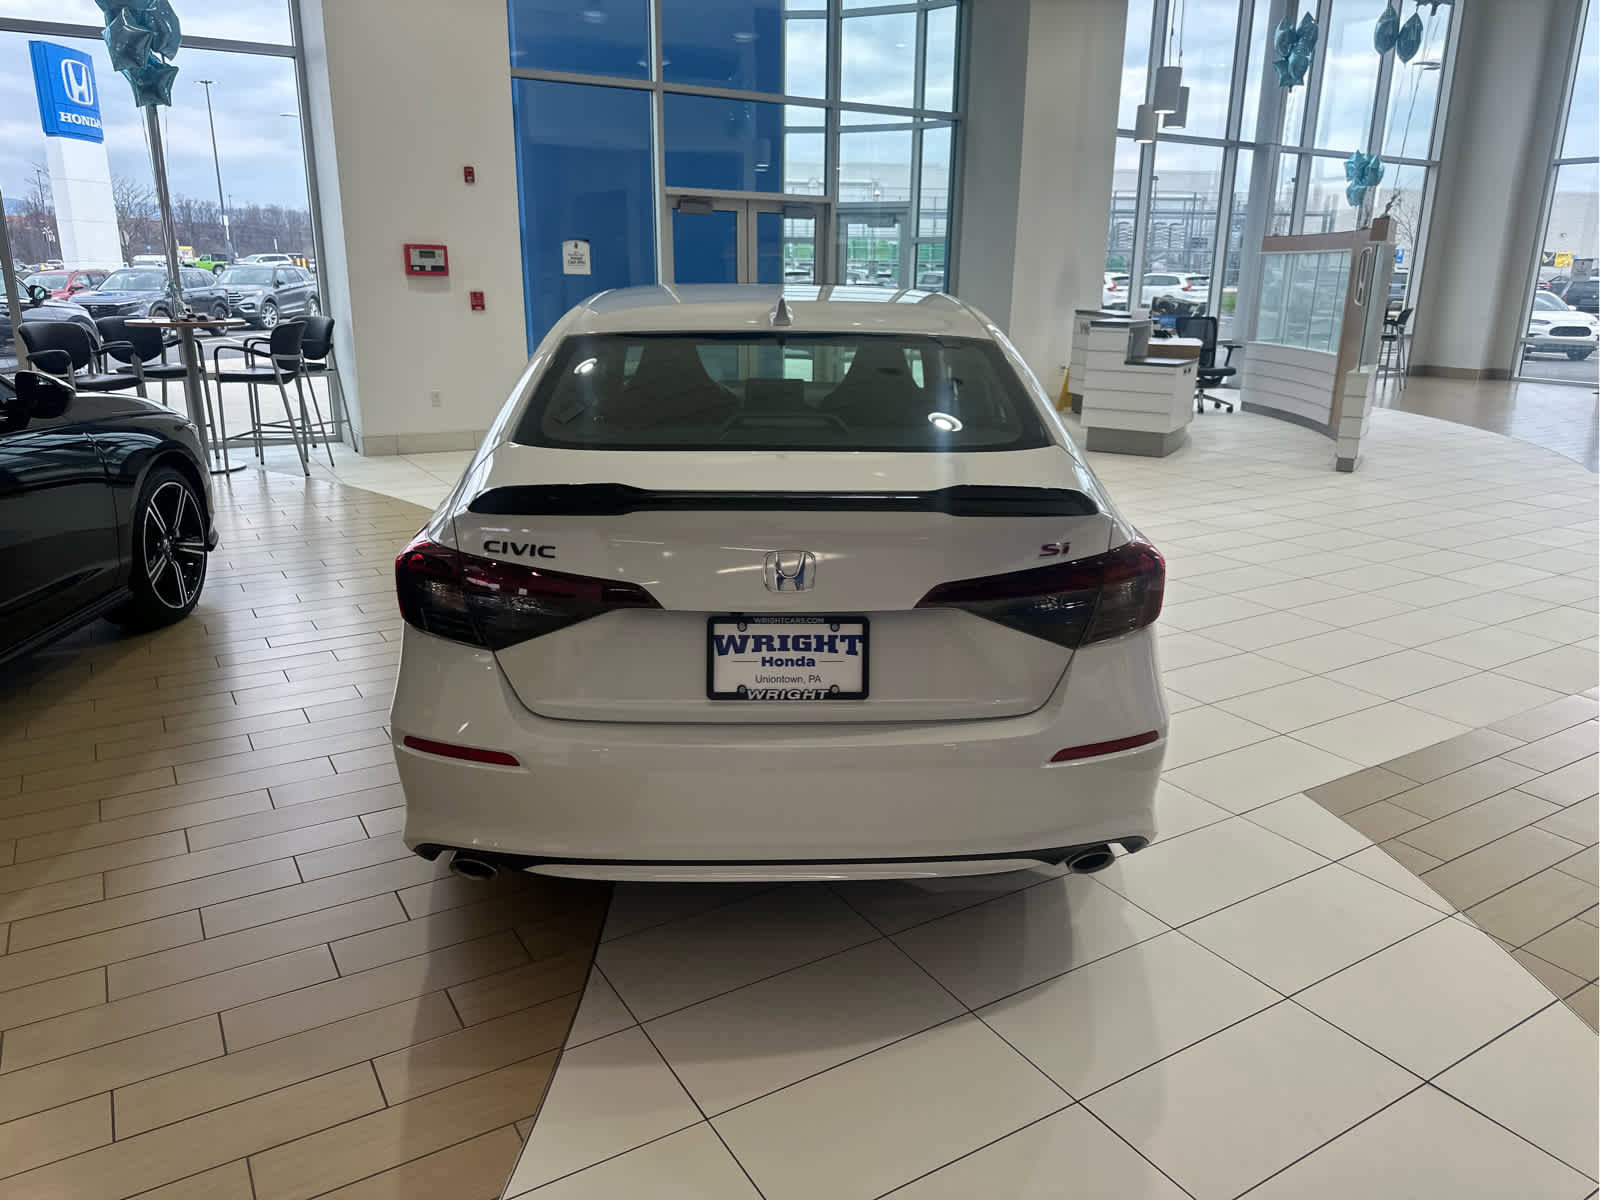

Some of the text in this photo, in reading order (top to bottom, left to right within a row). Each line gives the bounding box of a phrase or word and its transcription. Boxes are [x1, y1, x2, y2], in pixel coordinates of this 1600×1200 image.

[59, 112, 102, 129] HONDA
[483, 540, 557, 559] CIVIC
[1039, 542, 1072, 557] Si
[752, 617, 825, 625] WRIGHTCARS.COM
[711, 634, 864, 657] WRIGHT
[761, 656, 816, 667] Honda
[755, 674, 822, 685] Uniontown, PA
[747, 689, 829, 700] WRIGHT
